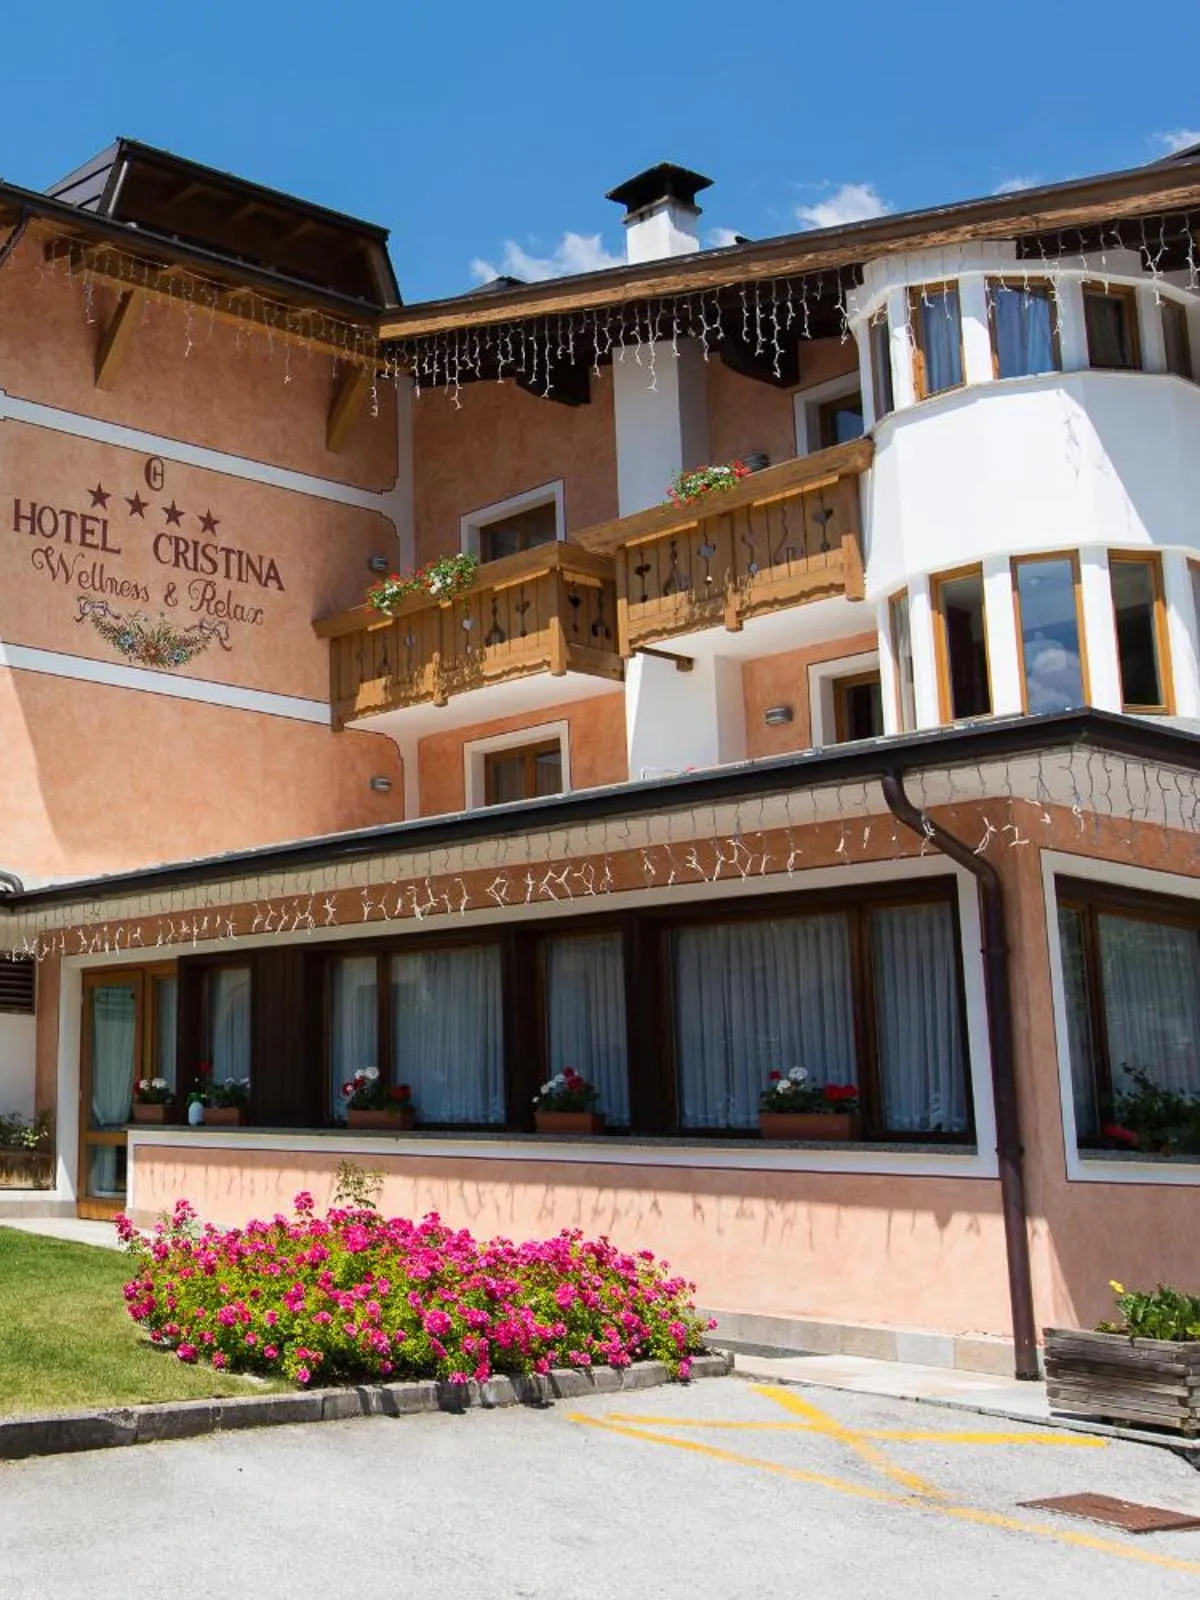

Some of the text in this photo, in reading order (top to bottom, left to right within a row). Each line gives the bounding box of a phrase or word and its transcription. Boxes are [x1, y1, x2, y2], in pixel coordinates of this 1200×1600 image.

[13, 498, 285, 591] HOTEL CRISTINA
[31, 546, 264, 626] Wellness & Relax
